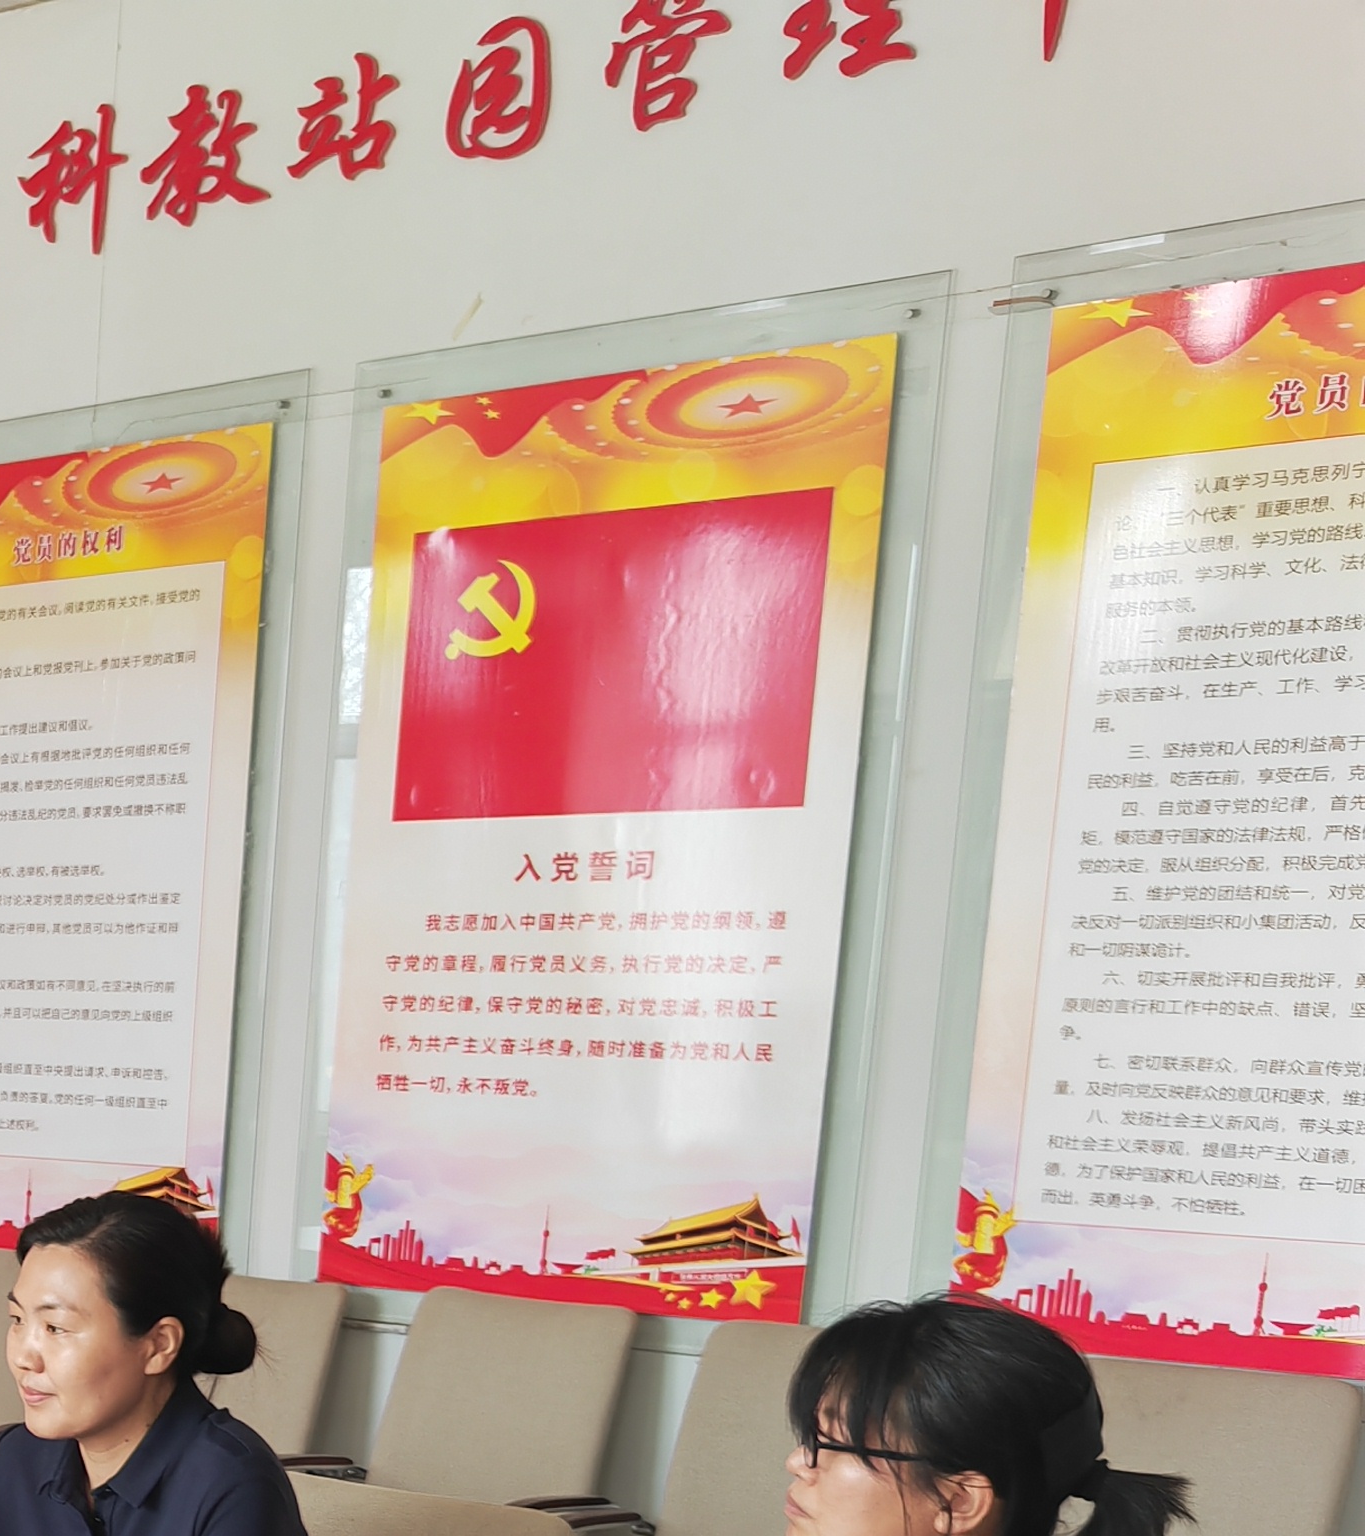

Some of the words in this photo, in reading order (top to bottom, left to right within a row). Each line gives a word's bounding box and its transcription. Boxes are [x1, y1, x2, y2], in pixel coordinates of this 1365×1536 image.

[11, 526, 126, 567] 党员的权利
[1105, 596, 1196, 618] 服务的本领。
[1092, 716, 1116, 733] 用。
[513, 849, 655, 883] 入党誓词
[1067, 942, 1191, 958] 和一切阴谋诡计。
[1058, 1025, 1082, 1040] 争。
